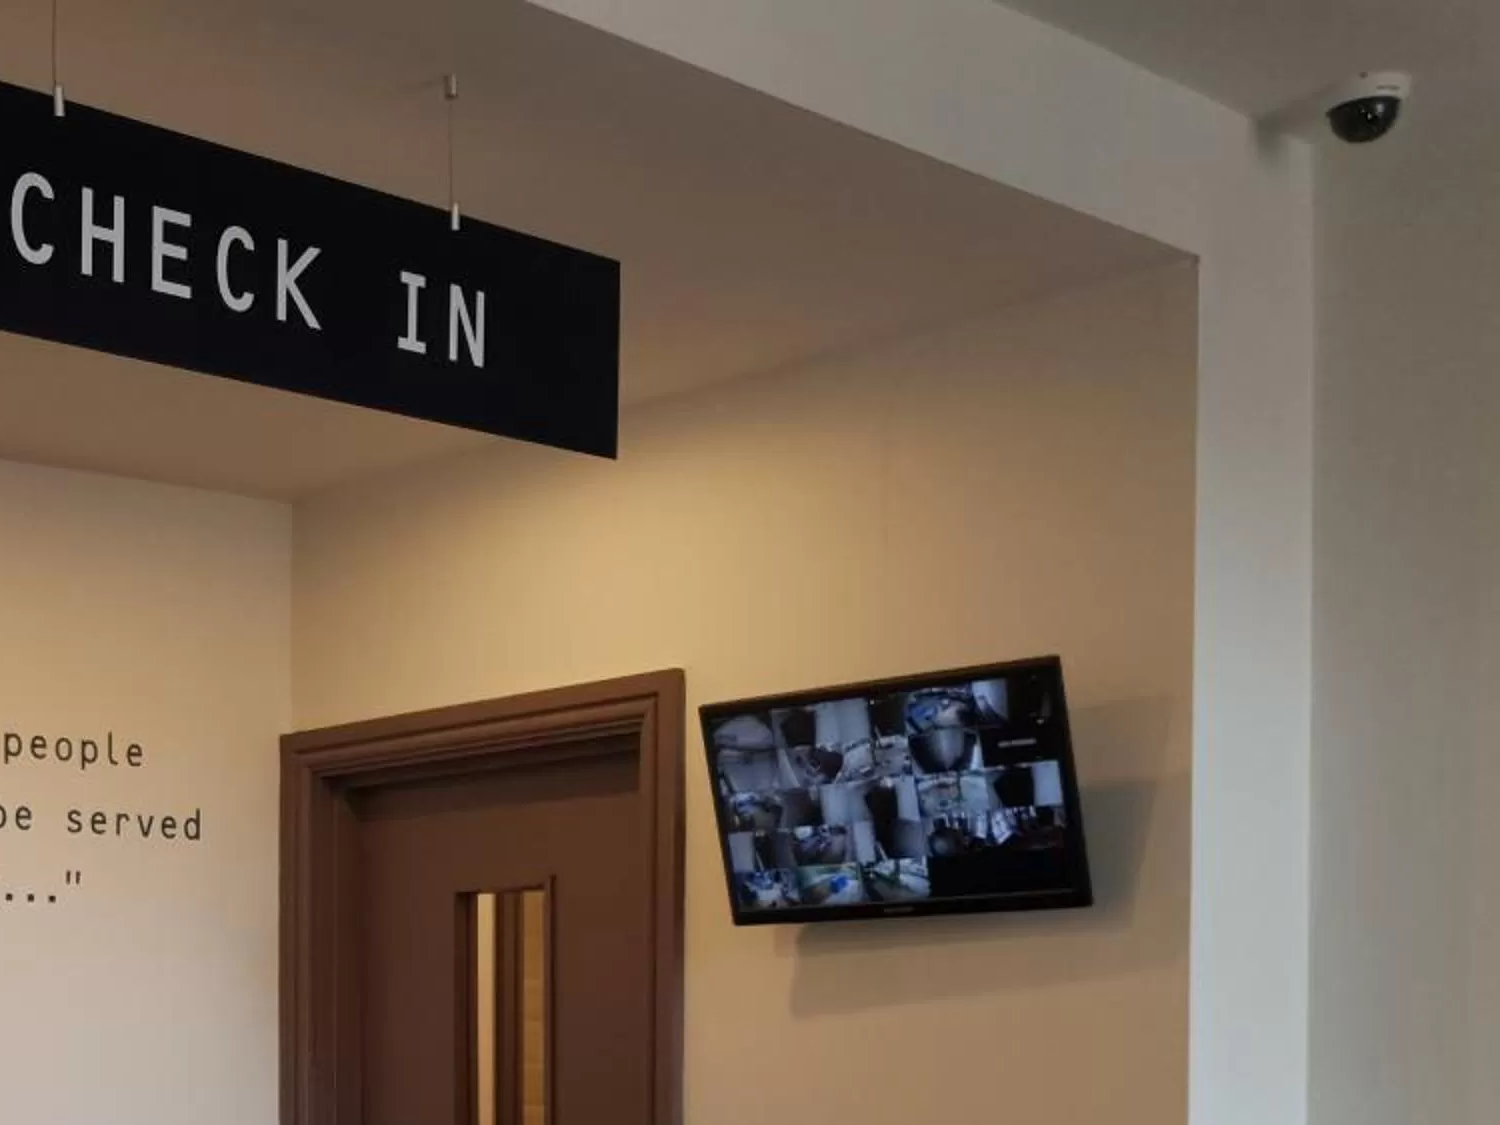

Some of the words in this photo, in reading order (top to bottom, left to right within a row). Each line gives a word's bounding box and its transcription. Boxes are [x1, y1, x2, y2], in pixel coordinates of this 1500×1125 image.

[10, 171, 322, 331] CHECK
[397, 270, 486, 369] IN
[3, 731, 143, 771] people
[67, 807, 201, 841] served
